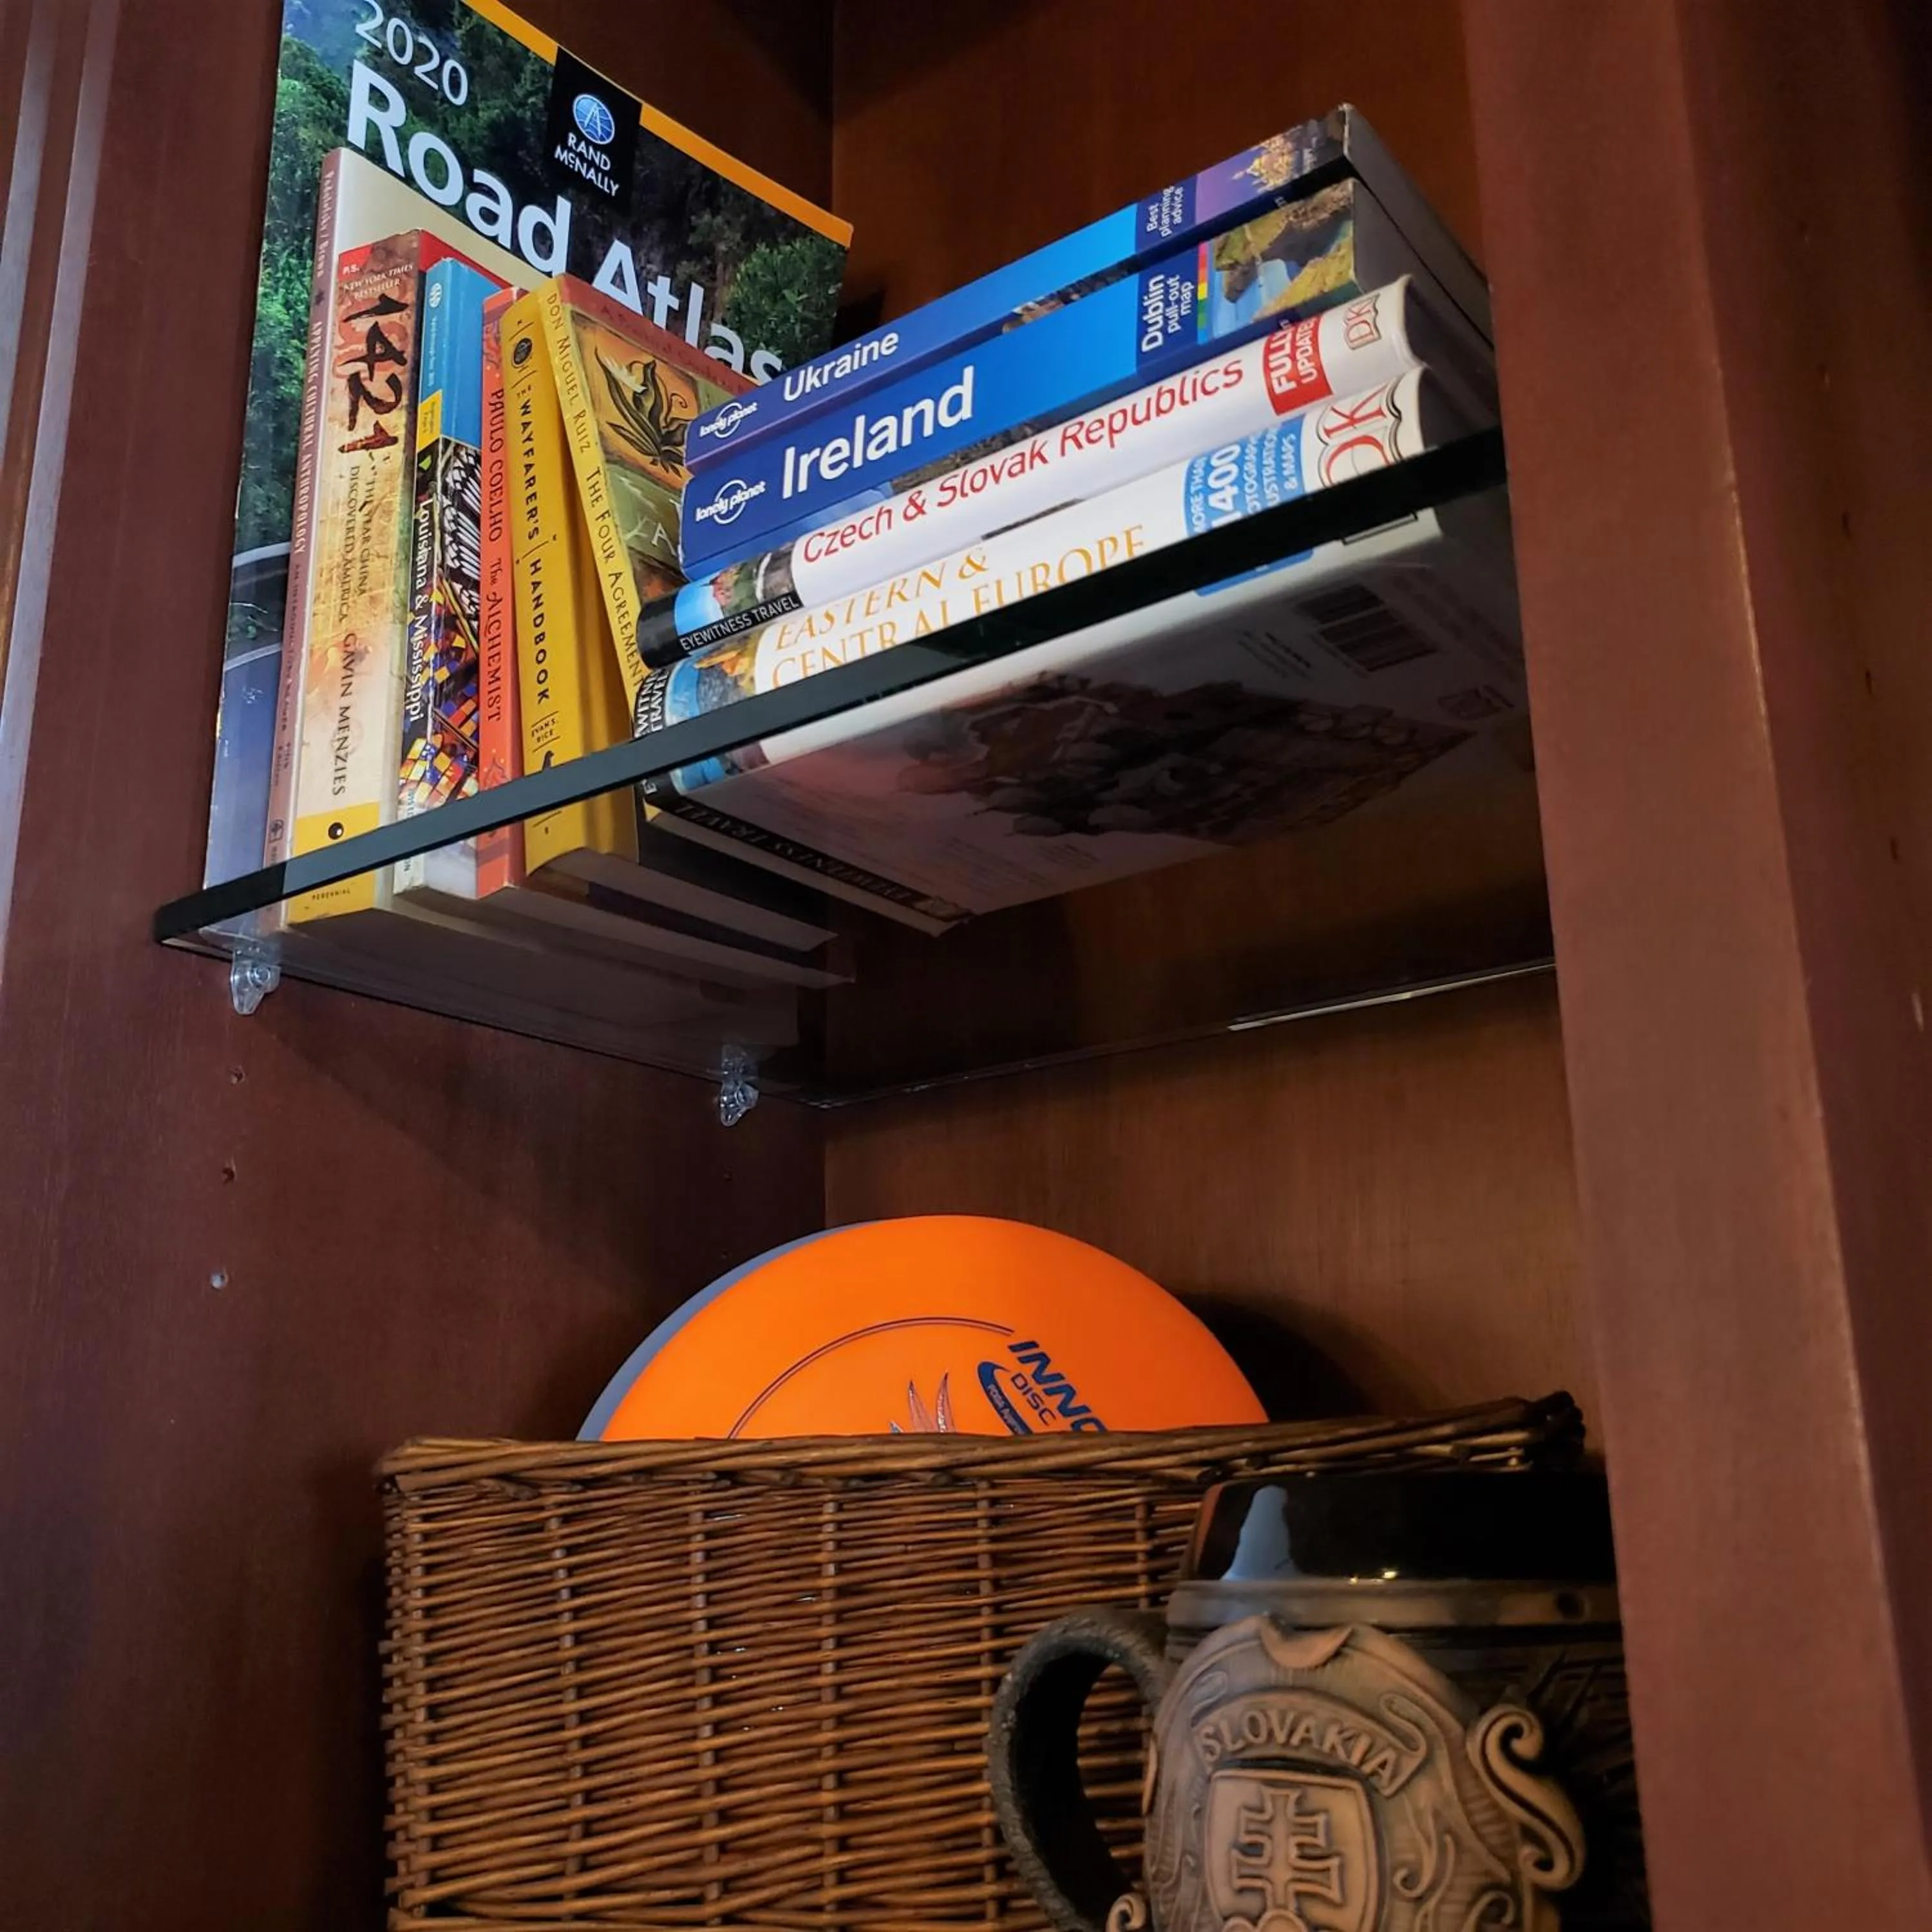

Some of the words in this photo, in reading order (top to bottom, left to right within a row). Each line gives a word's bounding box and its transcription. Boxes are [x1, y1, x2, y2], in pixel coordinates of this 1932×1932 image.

[355, 0, 468, 106] 2020
[567, 131, 611, 171] RAND
[347, 59, 572, 278] Road
[592, 240, 782, 385] Atlas
[1147, 203, 1159, 232] Best
[1159, 185, 1175, 238] planning
[1173, 186, 1184, 225] advice
[547, 293, 564, 330] DON
[1141, 274, 1164, 352] Dublin
[1168, 274, 1180, 334] pull-out
[1180, 281, 1195, 316] map
[1345, 295, 1379, 348] DK
[338, 292, 410, 453] 1421
[556, 335, 581, 407] MIGUEL
[783, 332, 899, 402] Ukraine
[303, 385, 317, 450] CULTURAL
[489, 388, 505, 451] PAULO
[573, 408, 591, 455] RUIZ
[699, 415, 729, 438] lonely
[728, 401, 759, 427] planet
[782, 365, 974, 500] Ireland
[518, 397, 541, 541] WAYFARER'S
[585, 466, 605, 509] THE
[803, 505, 893, 564] Czech
[903, 489, 928, 522] &
[936, 436, 1048, 507] Slovak
[1059, 358, 1245, 457] Republics
[294, 453, 312, 554] ANTHROPOLOGY
[344, 466, 360, 554] DISCOVERED
[488, 458, 505, 543] COELHO
[696, 498, 730, 523] lonely
[729, 480, 766, 509] planet
[415, 498, 433, 589] Louisiana
[594, 507, 617, 564] FOUR
[339, 556, 352, 623] AMERICA
[357, 547, 370, 596] CHINA
[415, 594, 430, 610] &
[489, 558, 502, 587] The
[775, 560, 947, 651] EASTERN
[956, 545, 990, 580] &
[529, 557, 551, 705] HANDBOOK
[679, 612, 752, 652] EYEWITNESS
[751, 594, 800, 620] TRAVEL
[772, 602, 949, 688] CENTRAL
[971, 524, 1144, 614] EUROPE
[332, 632, 357, 699] GAVIN
[404, 614, 429, 722] Mississippi
[484, 591, 504, 723] ALCHEMIST
[332, 705, 352, 797] MENZIES
[1010, 1372, 1057, 1426] DISC
[1200, 1708, 1396, 1784] SLOVAKIA
